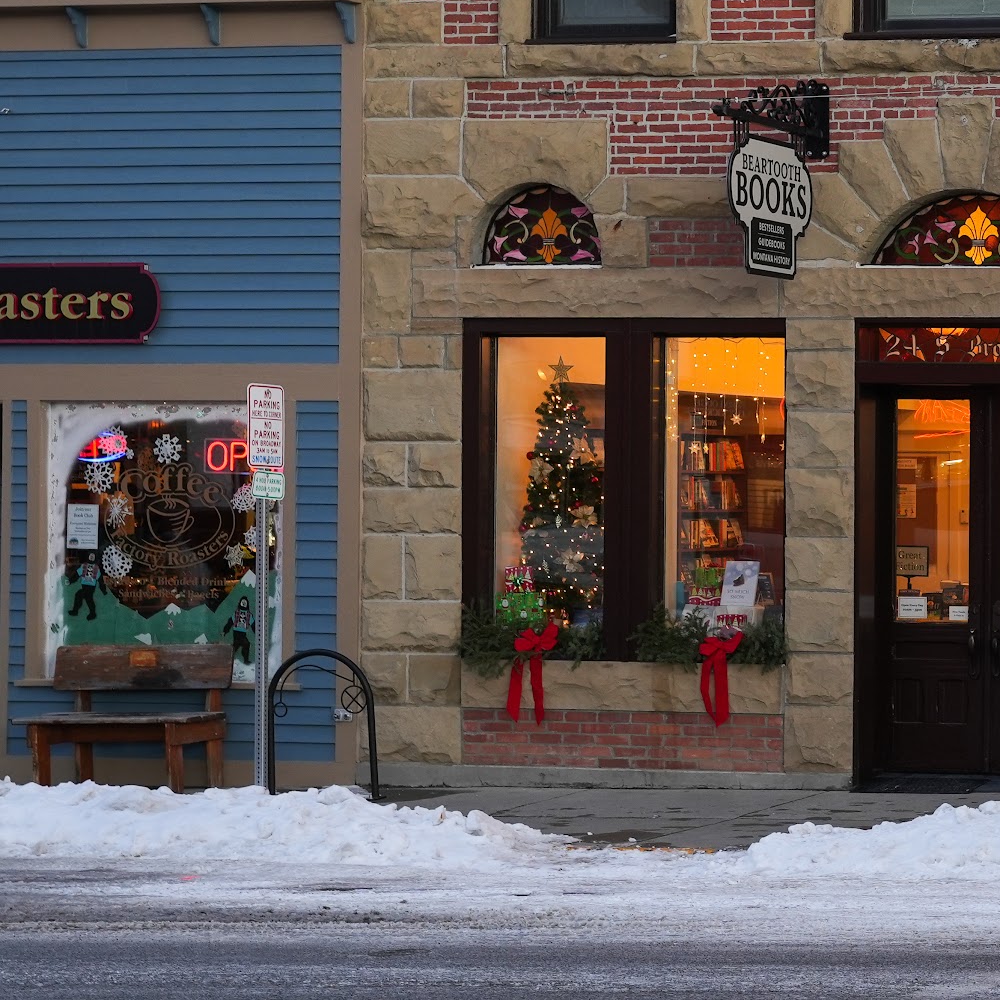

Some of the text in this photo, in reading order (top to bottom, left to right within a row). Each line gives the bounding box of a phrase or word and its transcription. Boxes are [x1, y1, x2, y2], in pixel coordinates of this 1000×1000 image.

[742, 153, 801, 182] BEARTOOTH
[736, 171, 806, 219] BOOKS
[759, 222, 785, 235] BESTSELLERS
[758, 237, 786, 250] GUIDEBOOKS
[752, 251, 791, 266] MONTANA HISTORY
[885, 334, 920, 357] 24
[264, 389, 272, 399] NO
[254, 400, 280, 410] PARKING
[264, 421, 272, 430] NO
[254, 430, 280, 440] PARKING
[252, 455, 267, 464] SNOW
[120, 465, 220, 504] Coffee
[167, 529, 229, 566] Roasters
[898, 550, 922, 560] Great
[157, 576, 199, 586] Blended
